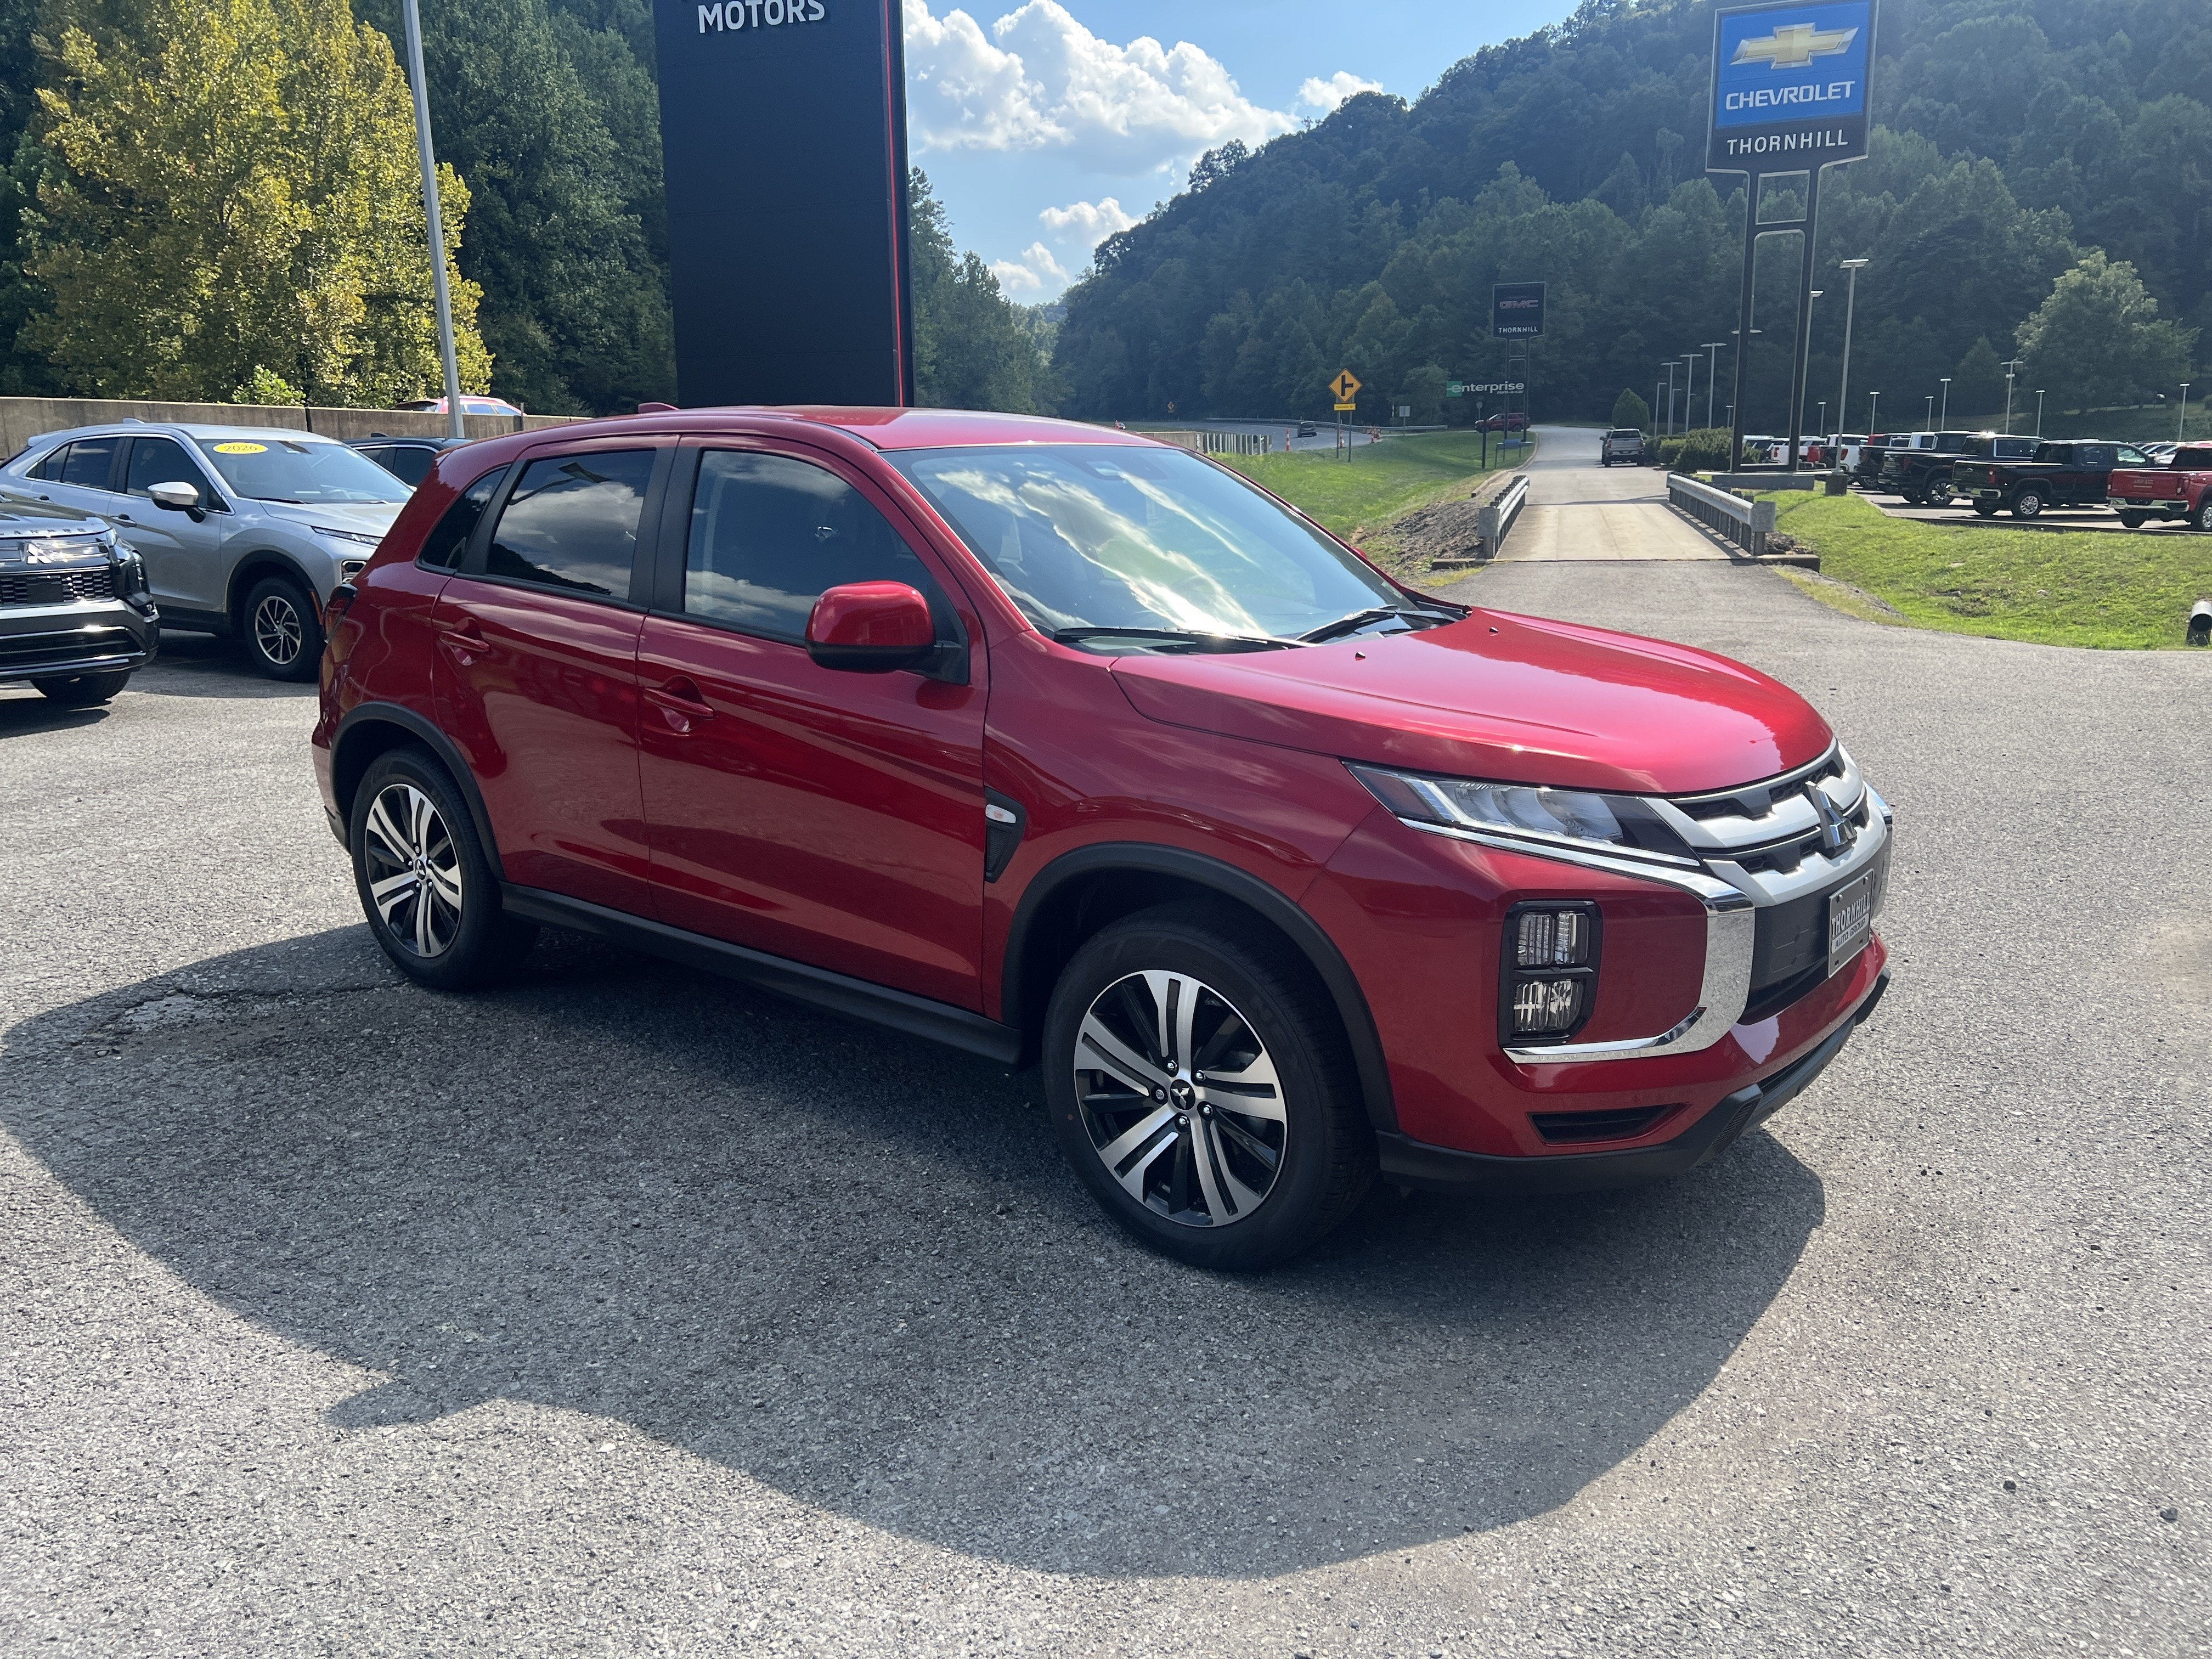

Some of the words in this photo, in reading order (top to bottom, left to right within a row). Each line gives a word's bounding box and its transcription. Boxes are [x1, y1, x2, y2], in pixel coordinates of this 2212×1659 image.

[698, 0, 825, 34] MOTORS
[1726, 81, 1855, 110] CHEVROLET
[1727, 129, 1848, 155] THORNHILL
[1499, 300, 1538, 309] GMC
[1447, 381, 1525, 394] enterprise
[1831, 891, 1870, 938] THORNHILL
[1835, 932, 1849, 949] AUTO
